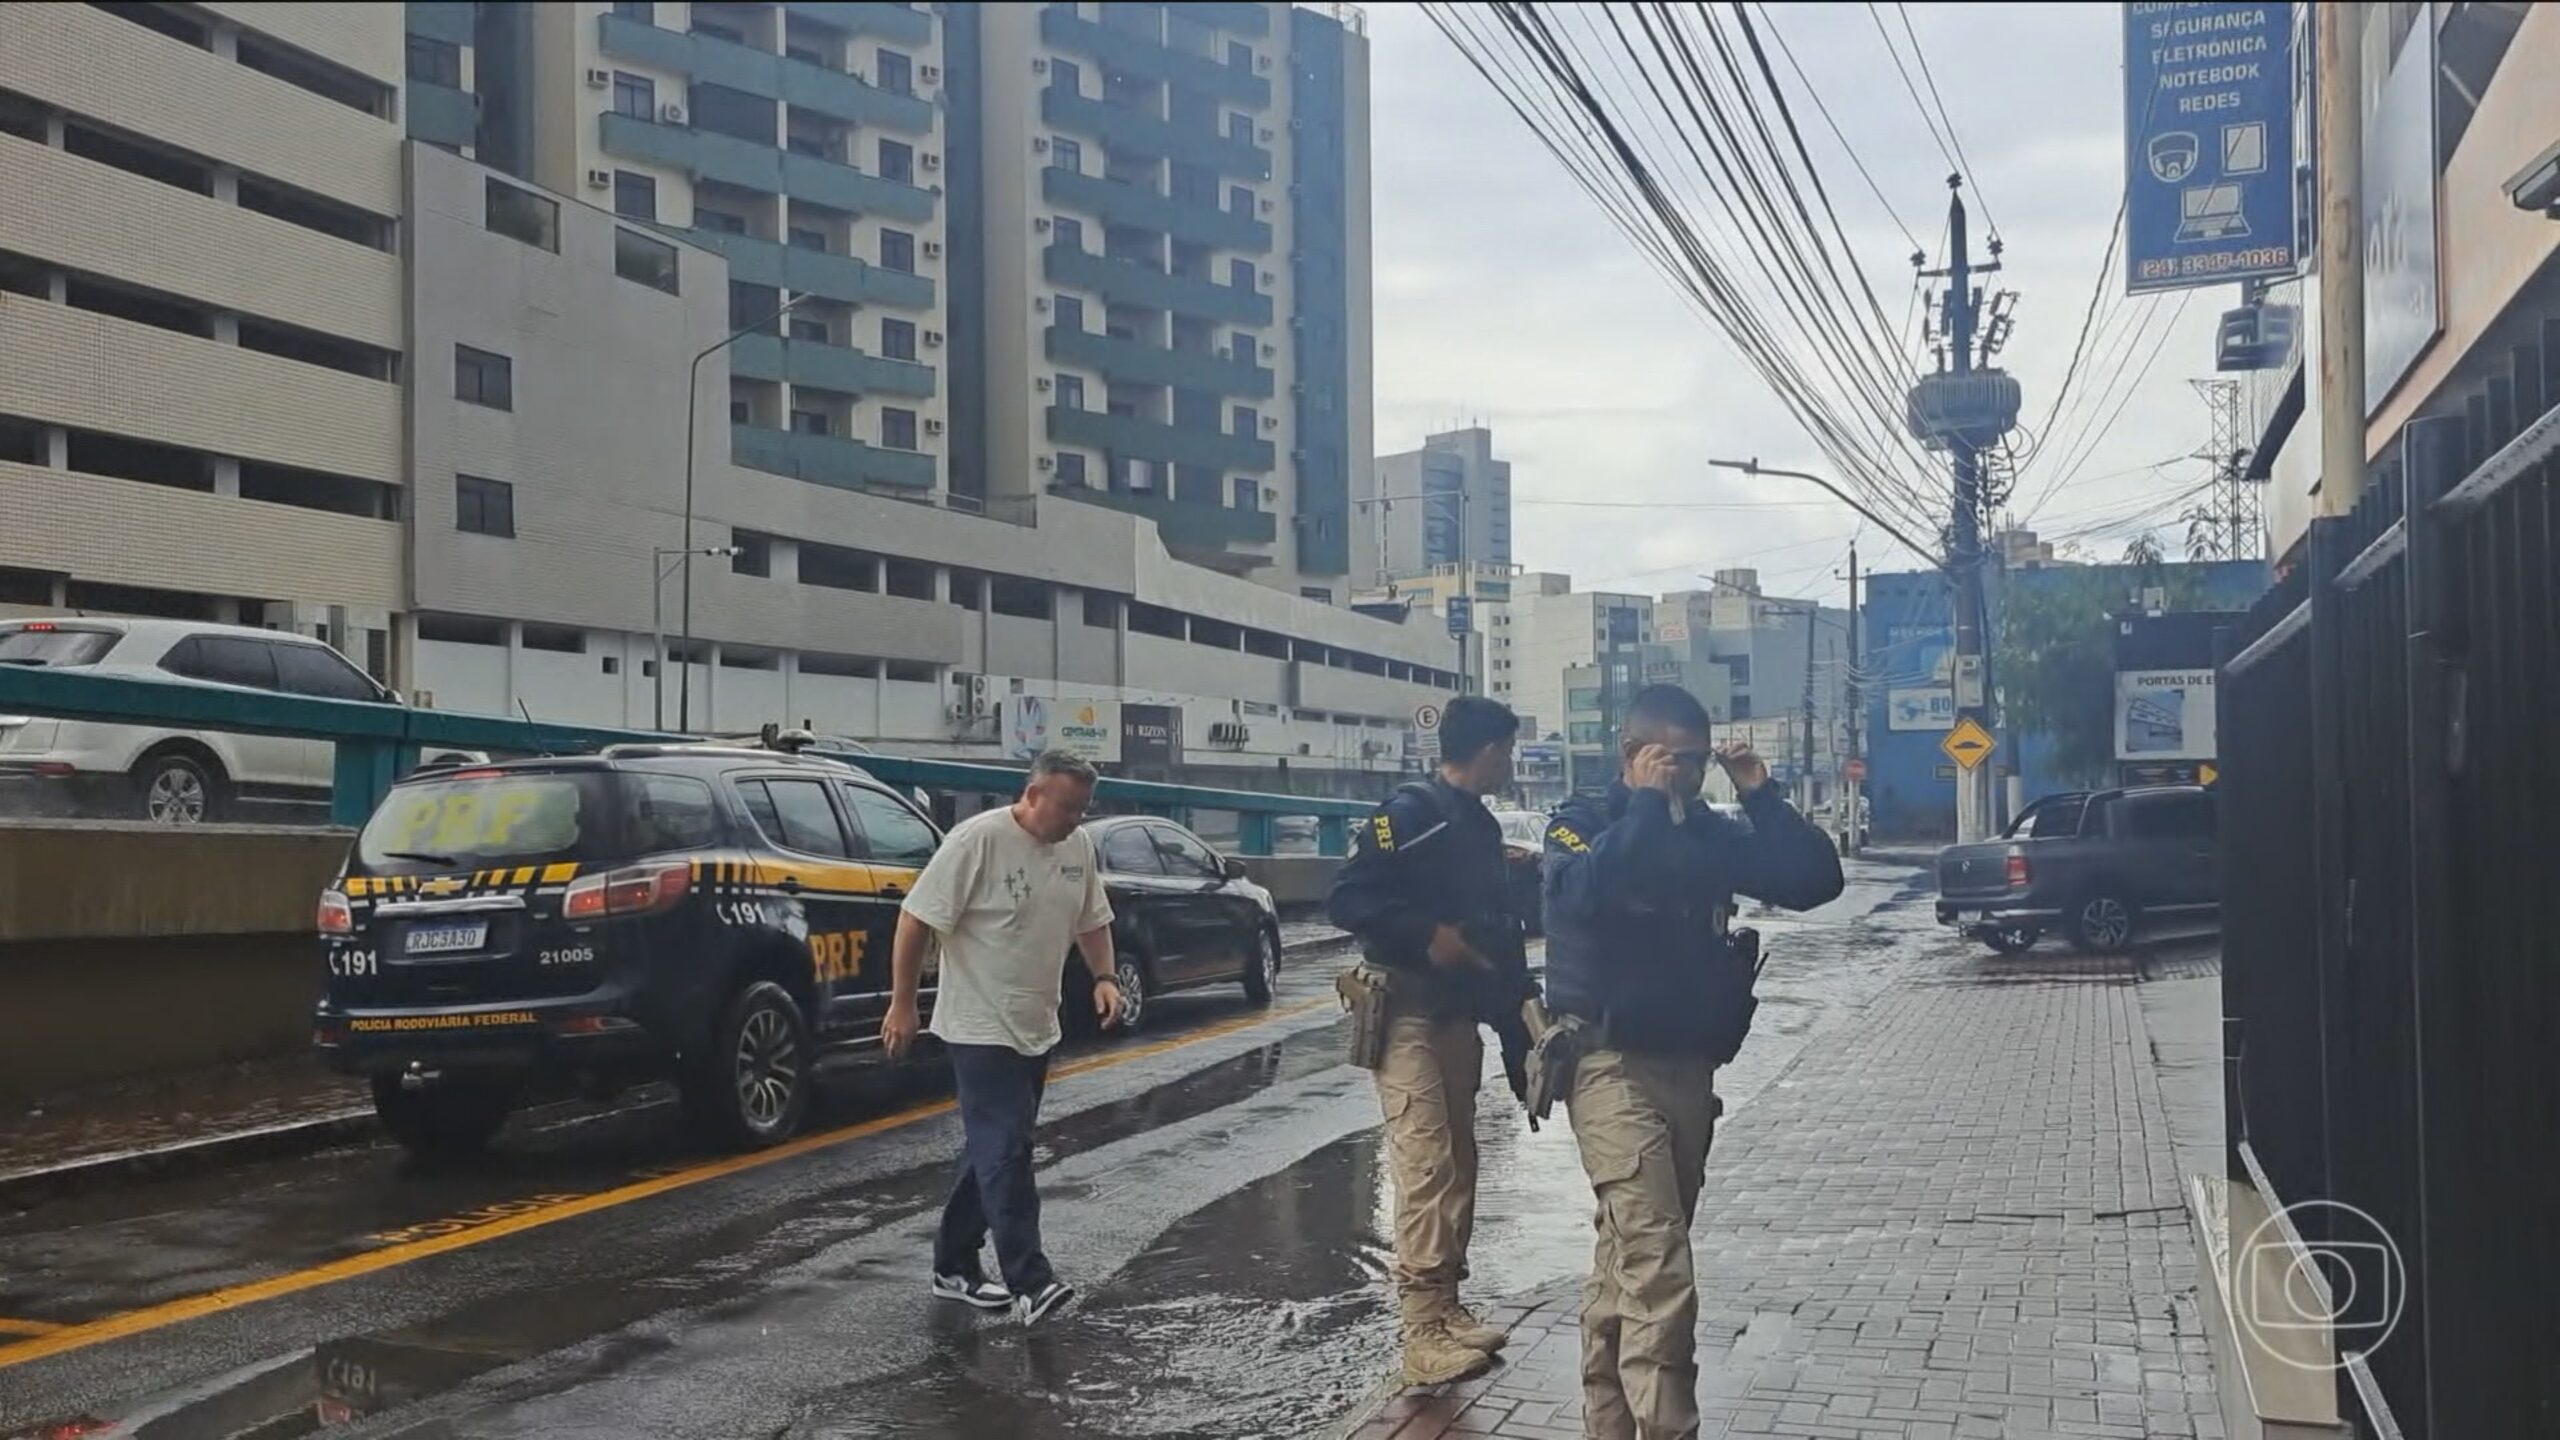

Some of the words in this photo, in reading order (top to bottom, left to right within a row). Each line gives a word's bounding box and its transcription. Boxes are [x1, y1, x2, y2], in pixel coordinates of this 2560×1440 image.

[2159, 63, 2260, 89] NOTEBOOK
[2178, 92, 2241, 113] REDES
[2137, 675, 2185, 686] PORTAS
[2187, 675, 2202, 685] DE
[2205, 675, 2216, 685] E
[1423, 709, 1433, 724] E
[1125, 723, 1167, 737] HRIZON
[1374, 815, 1395, 852] PRF
[1549, 825, 1593, 854] PRF
[730, 901, 767, 924] 191
[341, 950, 378, 976] 191
[539, 947, 594, 965] 21005
[808, 929, 868, 983] PRF
[474, 1011, 536, 1026] FEDERAL
